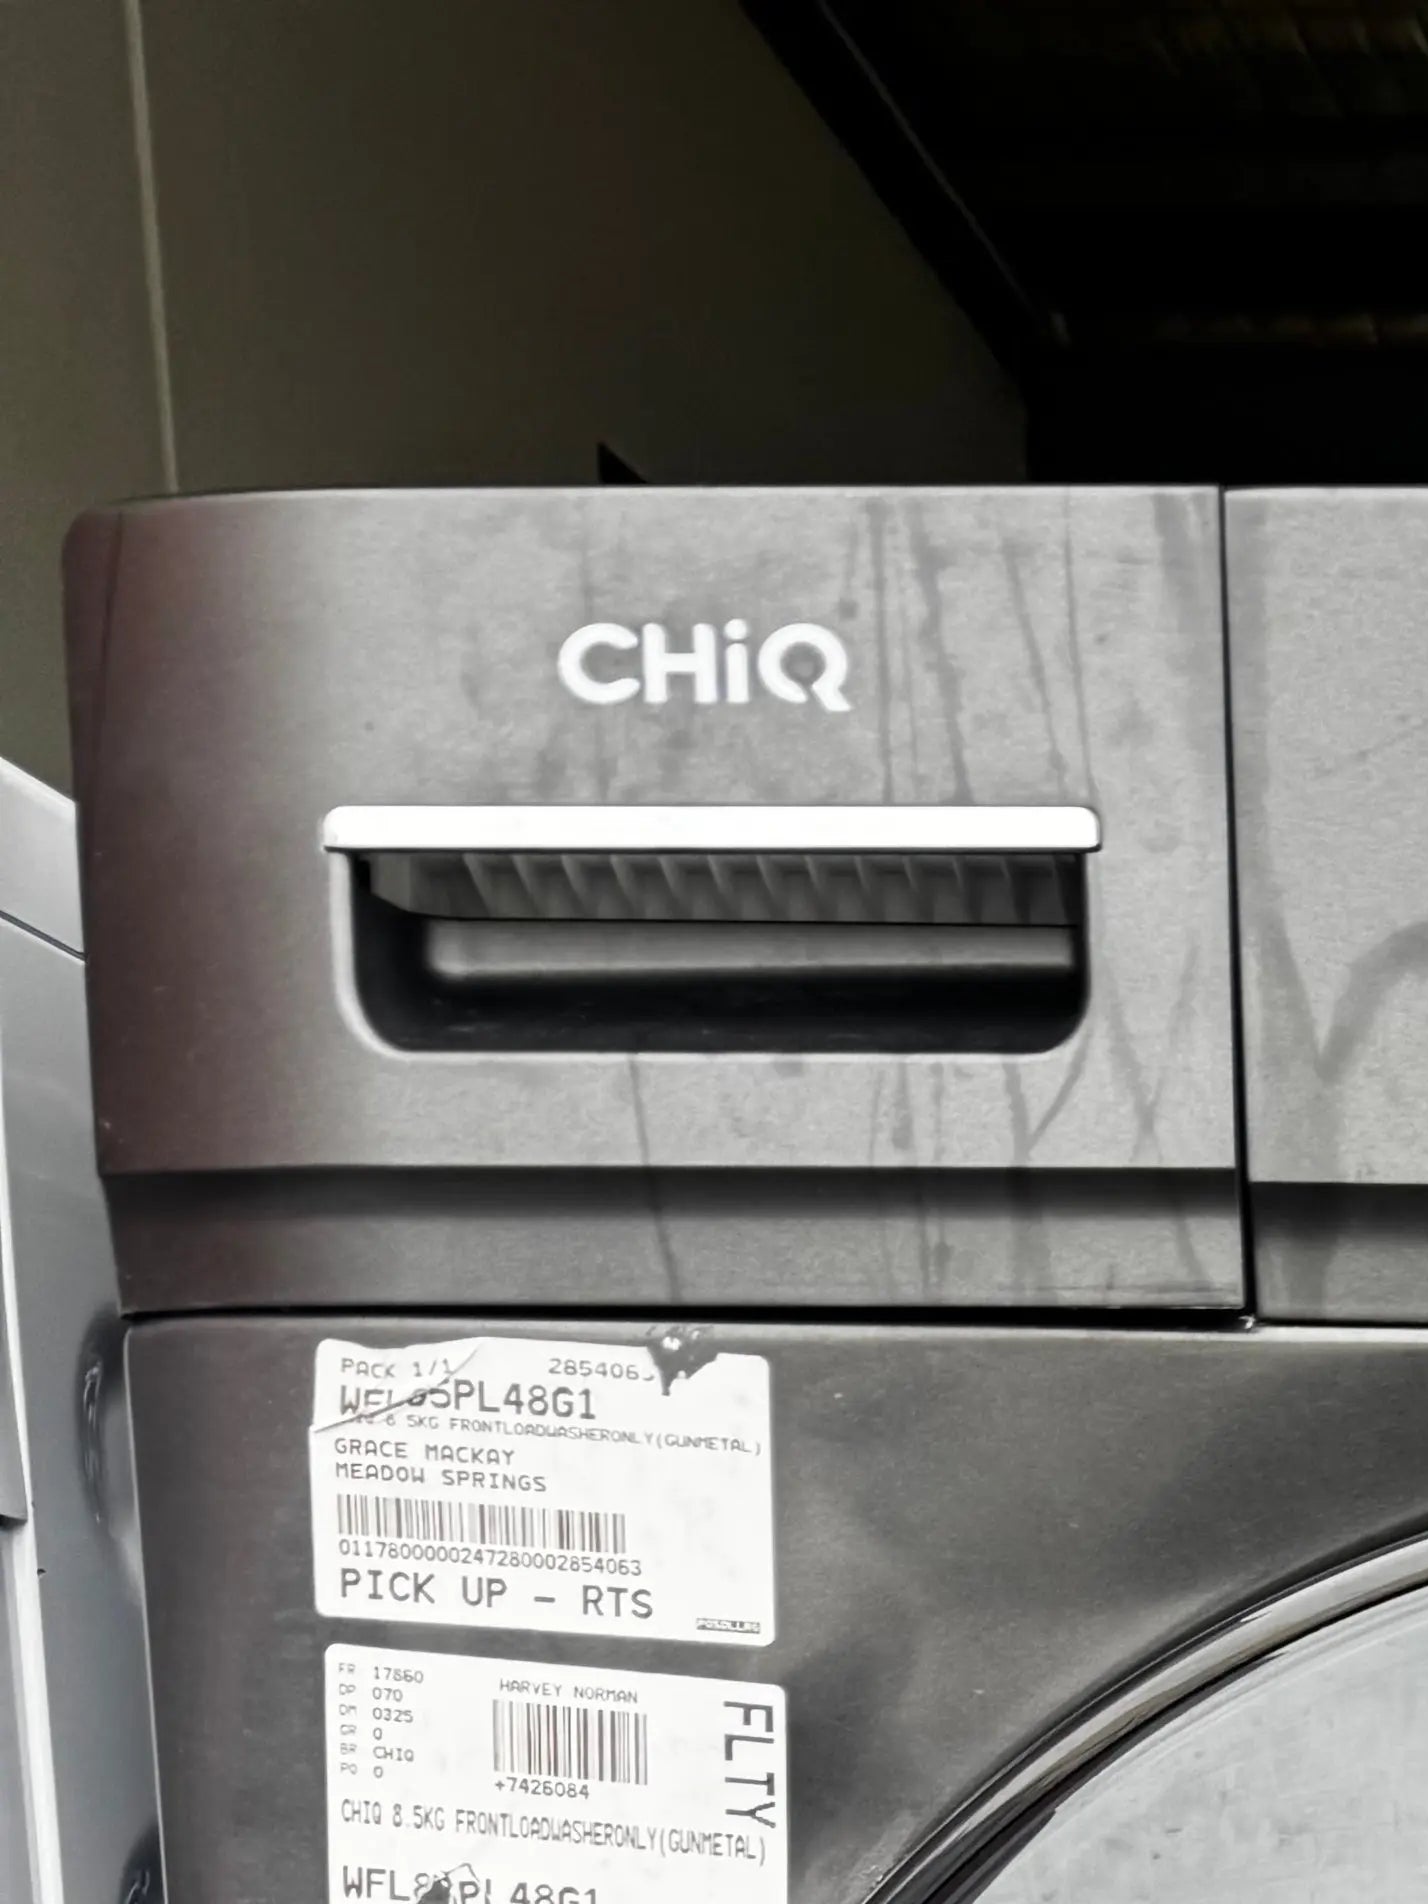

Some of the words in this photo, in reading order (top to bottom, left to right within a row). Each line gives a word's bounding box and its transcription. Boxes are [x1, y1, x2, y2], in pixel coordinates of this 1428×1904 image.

[557, 618, 852, 712] CHiQ
[341, 1357, 395, 1379] PACK
[412, 1357, 453, 1378] 1/1
[334, 1437, 408, 1459] GRACE
[424, 1444, 515, 1466] MACKAY
[335, 1462, 425, 1484] MEADOW
[441, 1468, 547, 1493] SPRINGS
[340, 1567, 435, 1604] PICK
[461, 1575, 508, 1608] UP
[582, 1584, 653, 1620] RTS
[372, 1686, 404, 1703] 070
[499, 1678, 562, 1697] HARVEY
[573, 1685, 638, 1704] NORMAN
[372, 1706, 414, 1724] 0325
[372, 1746, 415, 1763] CHIQ
[722, 1700, 776, 1829] FLTY
[494, 1772, 590, 1800] +7426084
[341, 1798, 382, 1826] CHIQ
